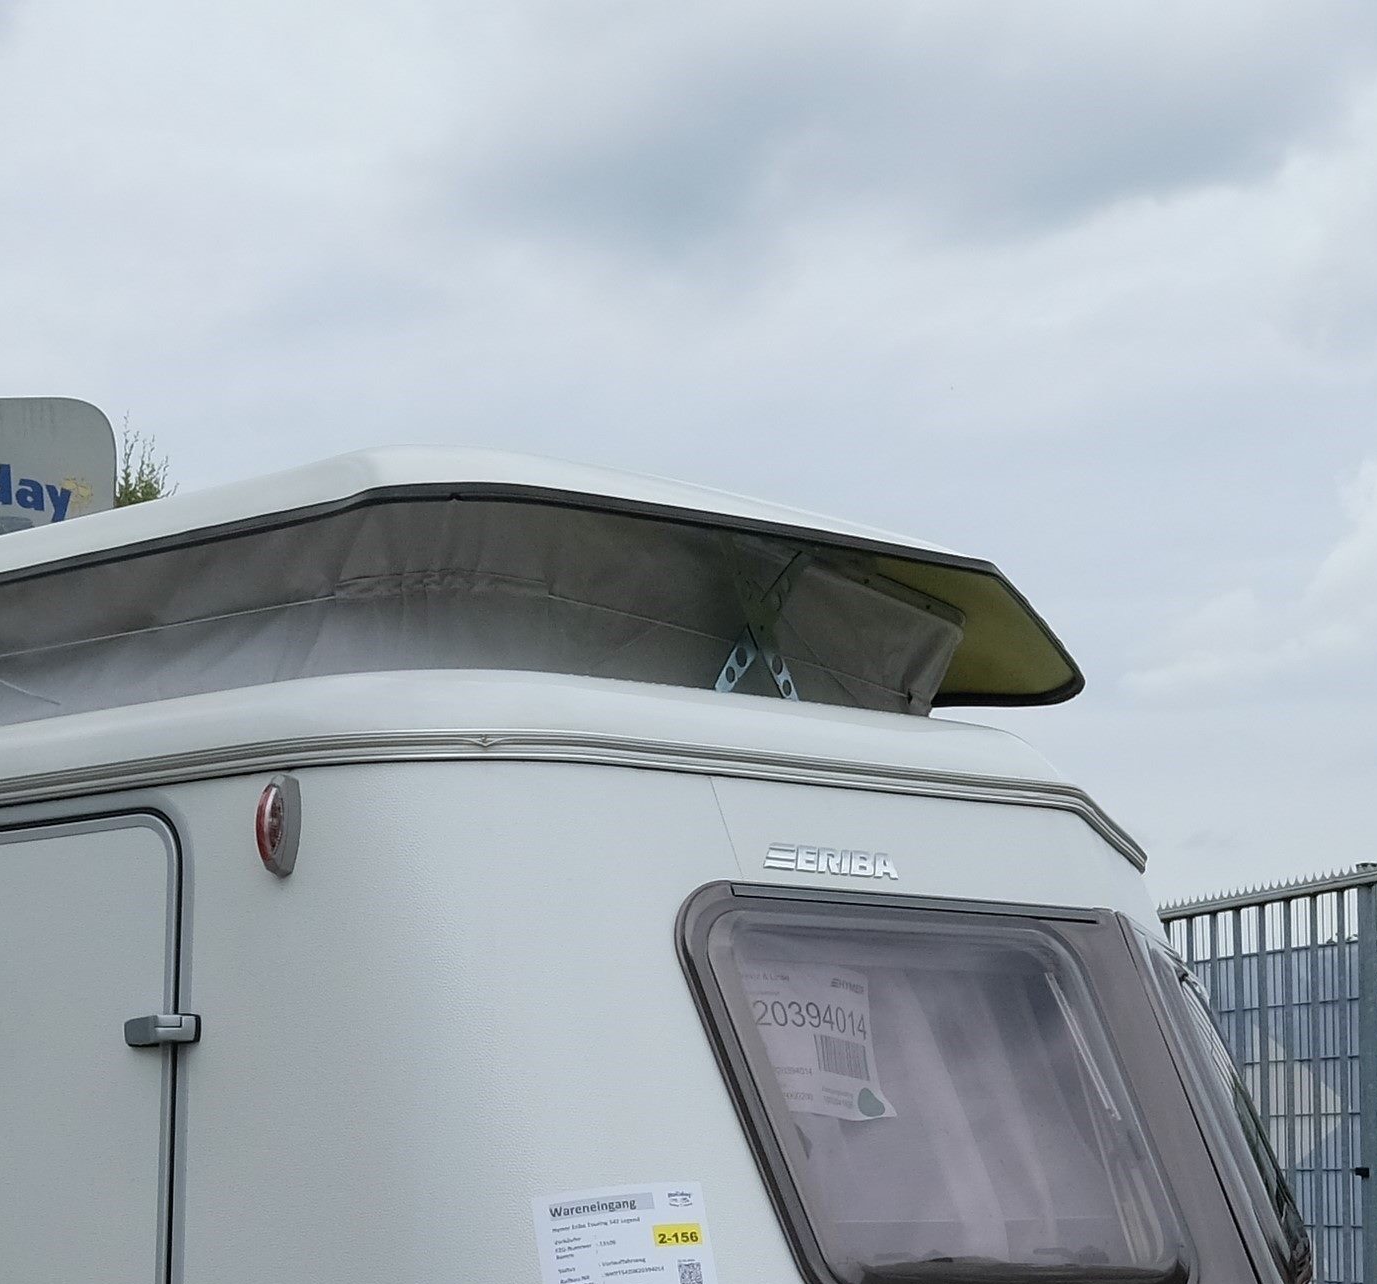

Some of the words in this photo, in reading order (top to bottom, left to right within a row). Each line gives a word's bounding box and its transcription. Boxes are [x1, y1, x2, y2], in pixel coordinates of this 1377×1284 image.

[795, 845, 899, 880] ERIBA
[753, 999, 868, 1041] 20394014
[549, 1199, 637, 1218] Wareneingang
[658, 1231, 699, 1245] 2-156
